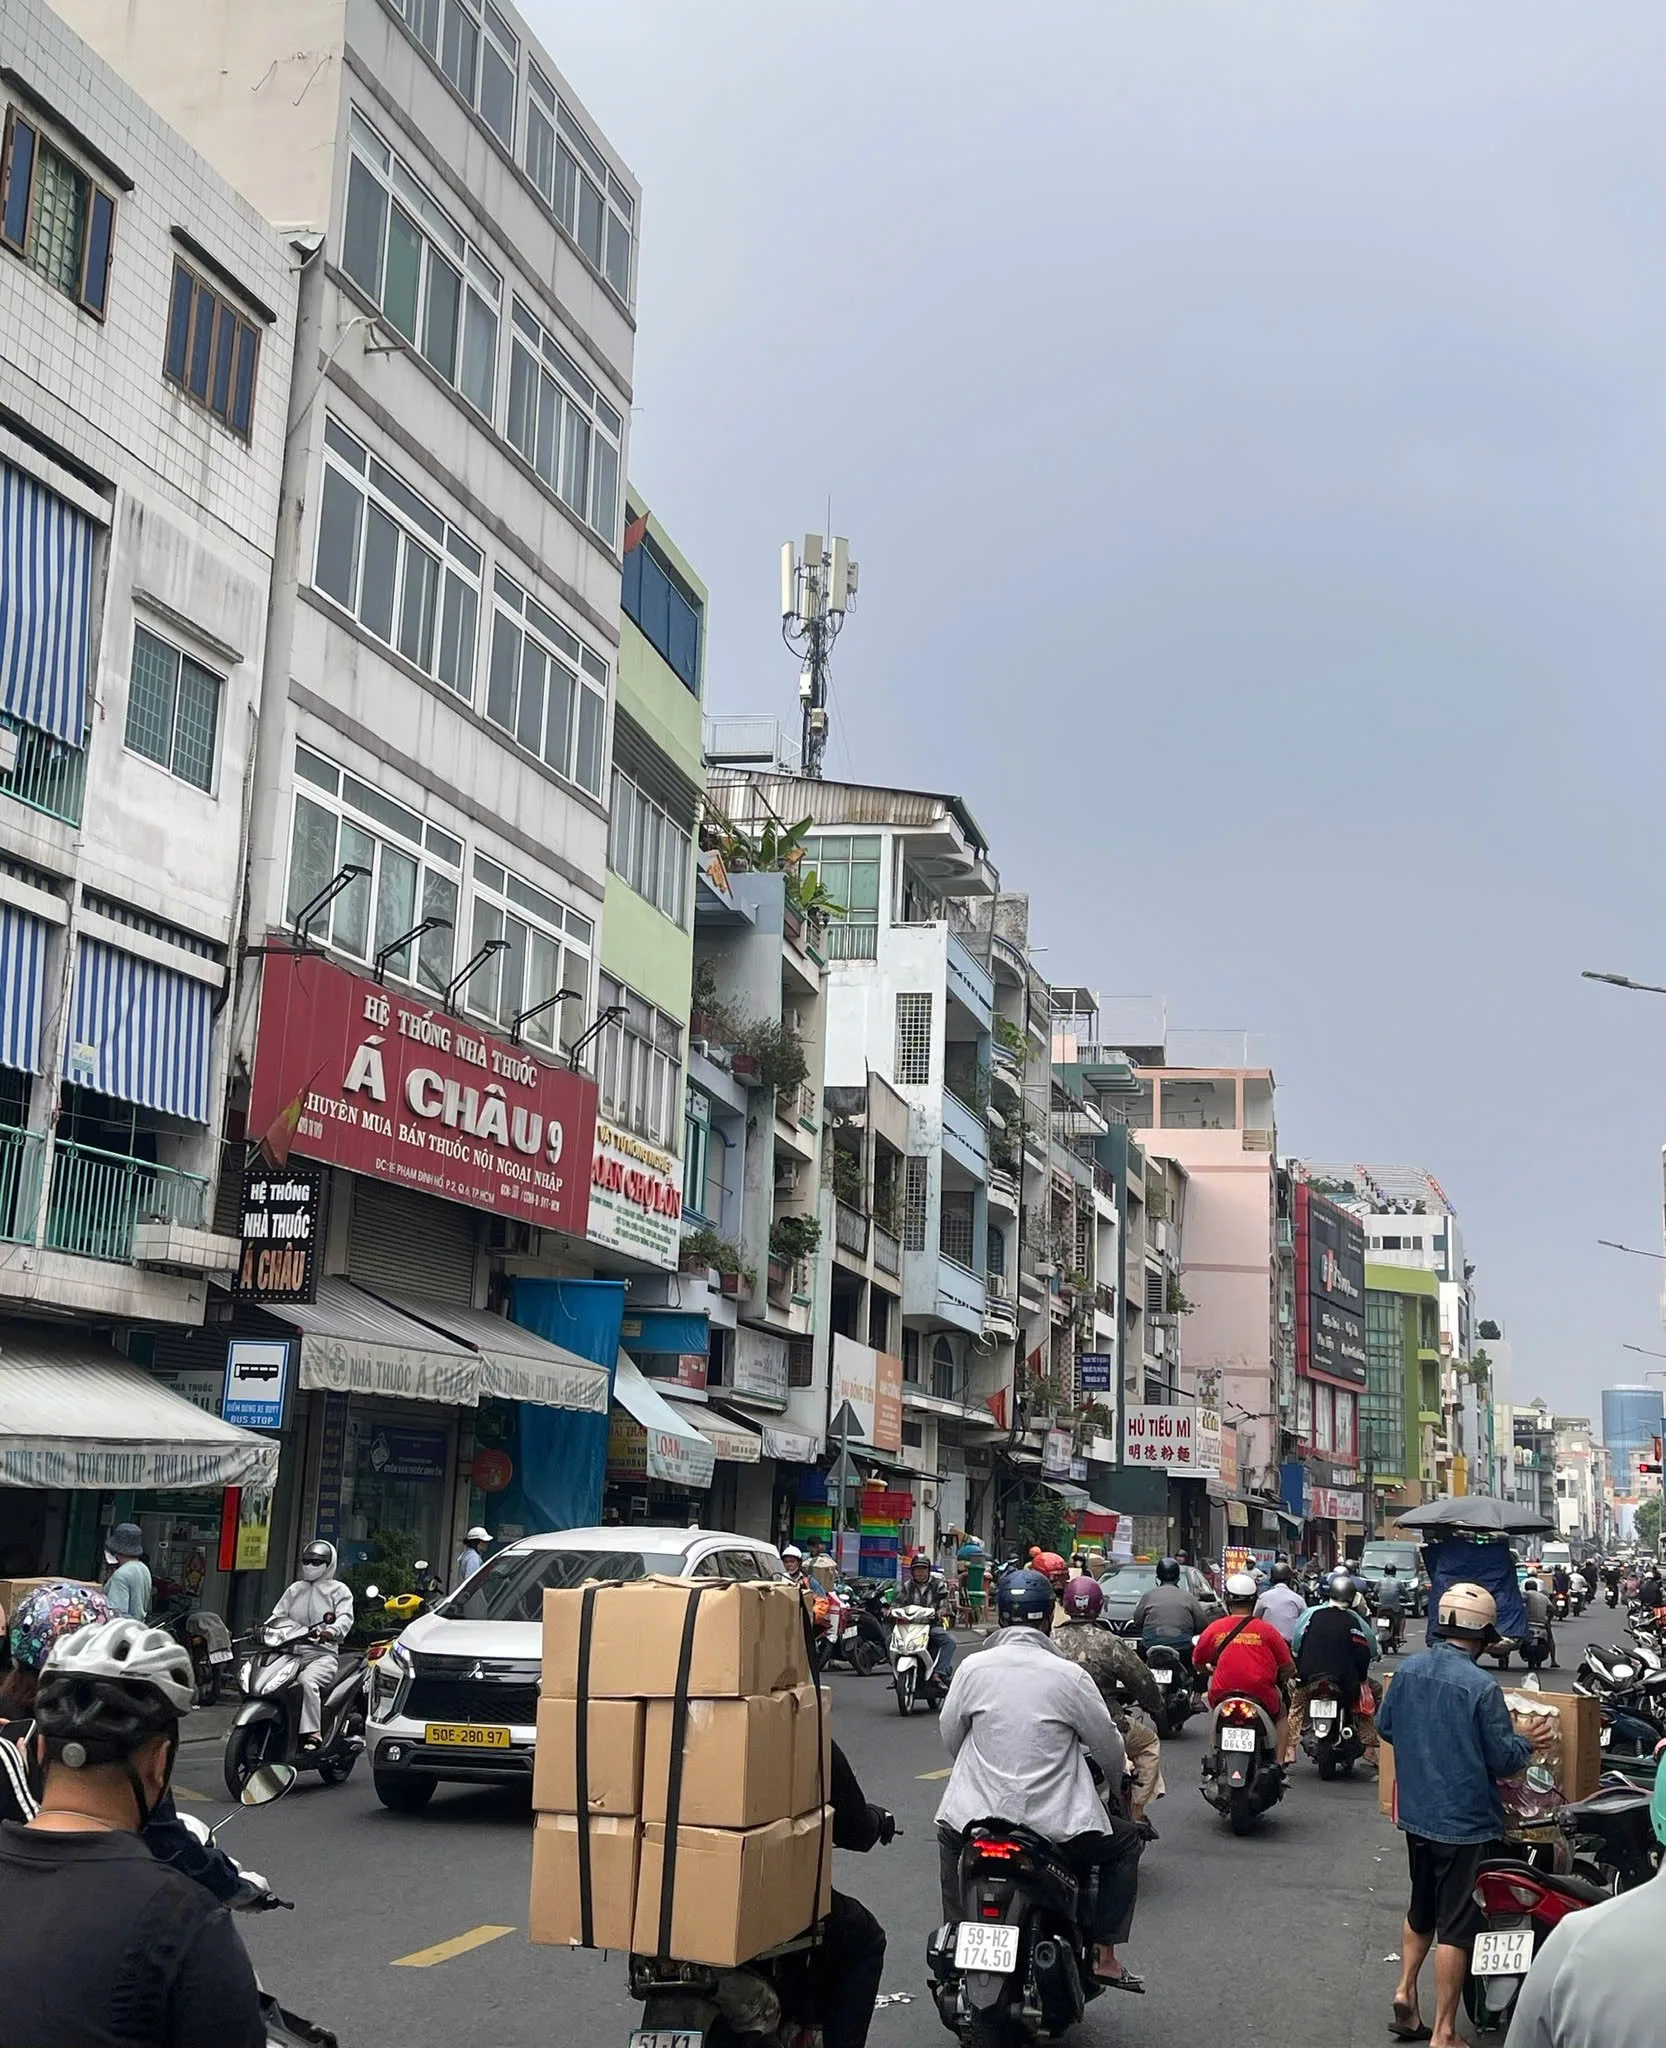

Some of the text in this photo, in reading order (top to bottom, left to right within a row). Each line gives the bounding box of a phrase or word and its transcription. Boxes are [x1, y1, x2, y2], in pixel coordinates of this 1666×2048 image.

[363, 994, 538, 1088] HỆ THỐNG NHÀ THUỐC
[343, 1034, 563, 1165] Á CHÂU 9
[304, 1092, 563, 1194] HUYÊN MUA BÁN THUỐC NỘI NGOẠI NHẬP
[396, 1164, 417, 1180] PHẠM
[250, 1179, 311, 1204] HỆ THỐNG
[624, 1169, 655, 1215] CHỢ
[653, 1177, 681, 1219] LỚN
[243, 1206, 311, 1239] NHÀ THUỐC
[239, 1241, 306, 1291] Á CHÂU
[349, 1352, 372, 1388] NHÀ
[376, 1353, 411, 1392] THUỐC
[416, 1356, 428, 1394] Á
[188, 1381, 214, 1392] THUỐC
[230, 1415, 274, 1425] BUS STOP
[1128, 1412, 1190, 1438] HỦ TIẾU MÌ
[655, 1433, 680, 1460] LOAN
[967, 1927, 1010, 1948] 59-H2
[1483, 1935, 1525, 1952] 51-L7
[963, 1947, 1012, 1968] 174.50
[1481, 1953, 1522, 1971] 3940
[639, 2034, 691, 2048] 51-K1
